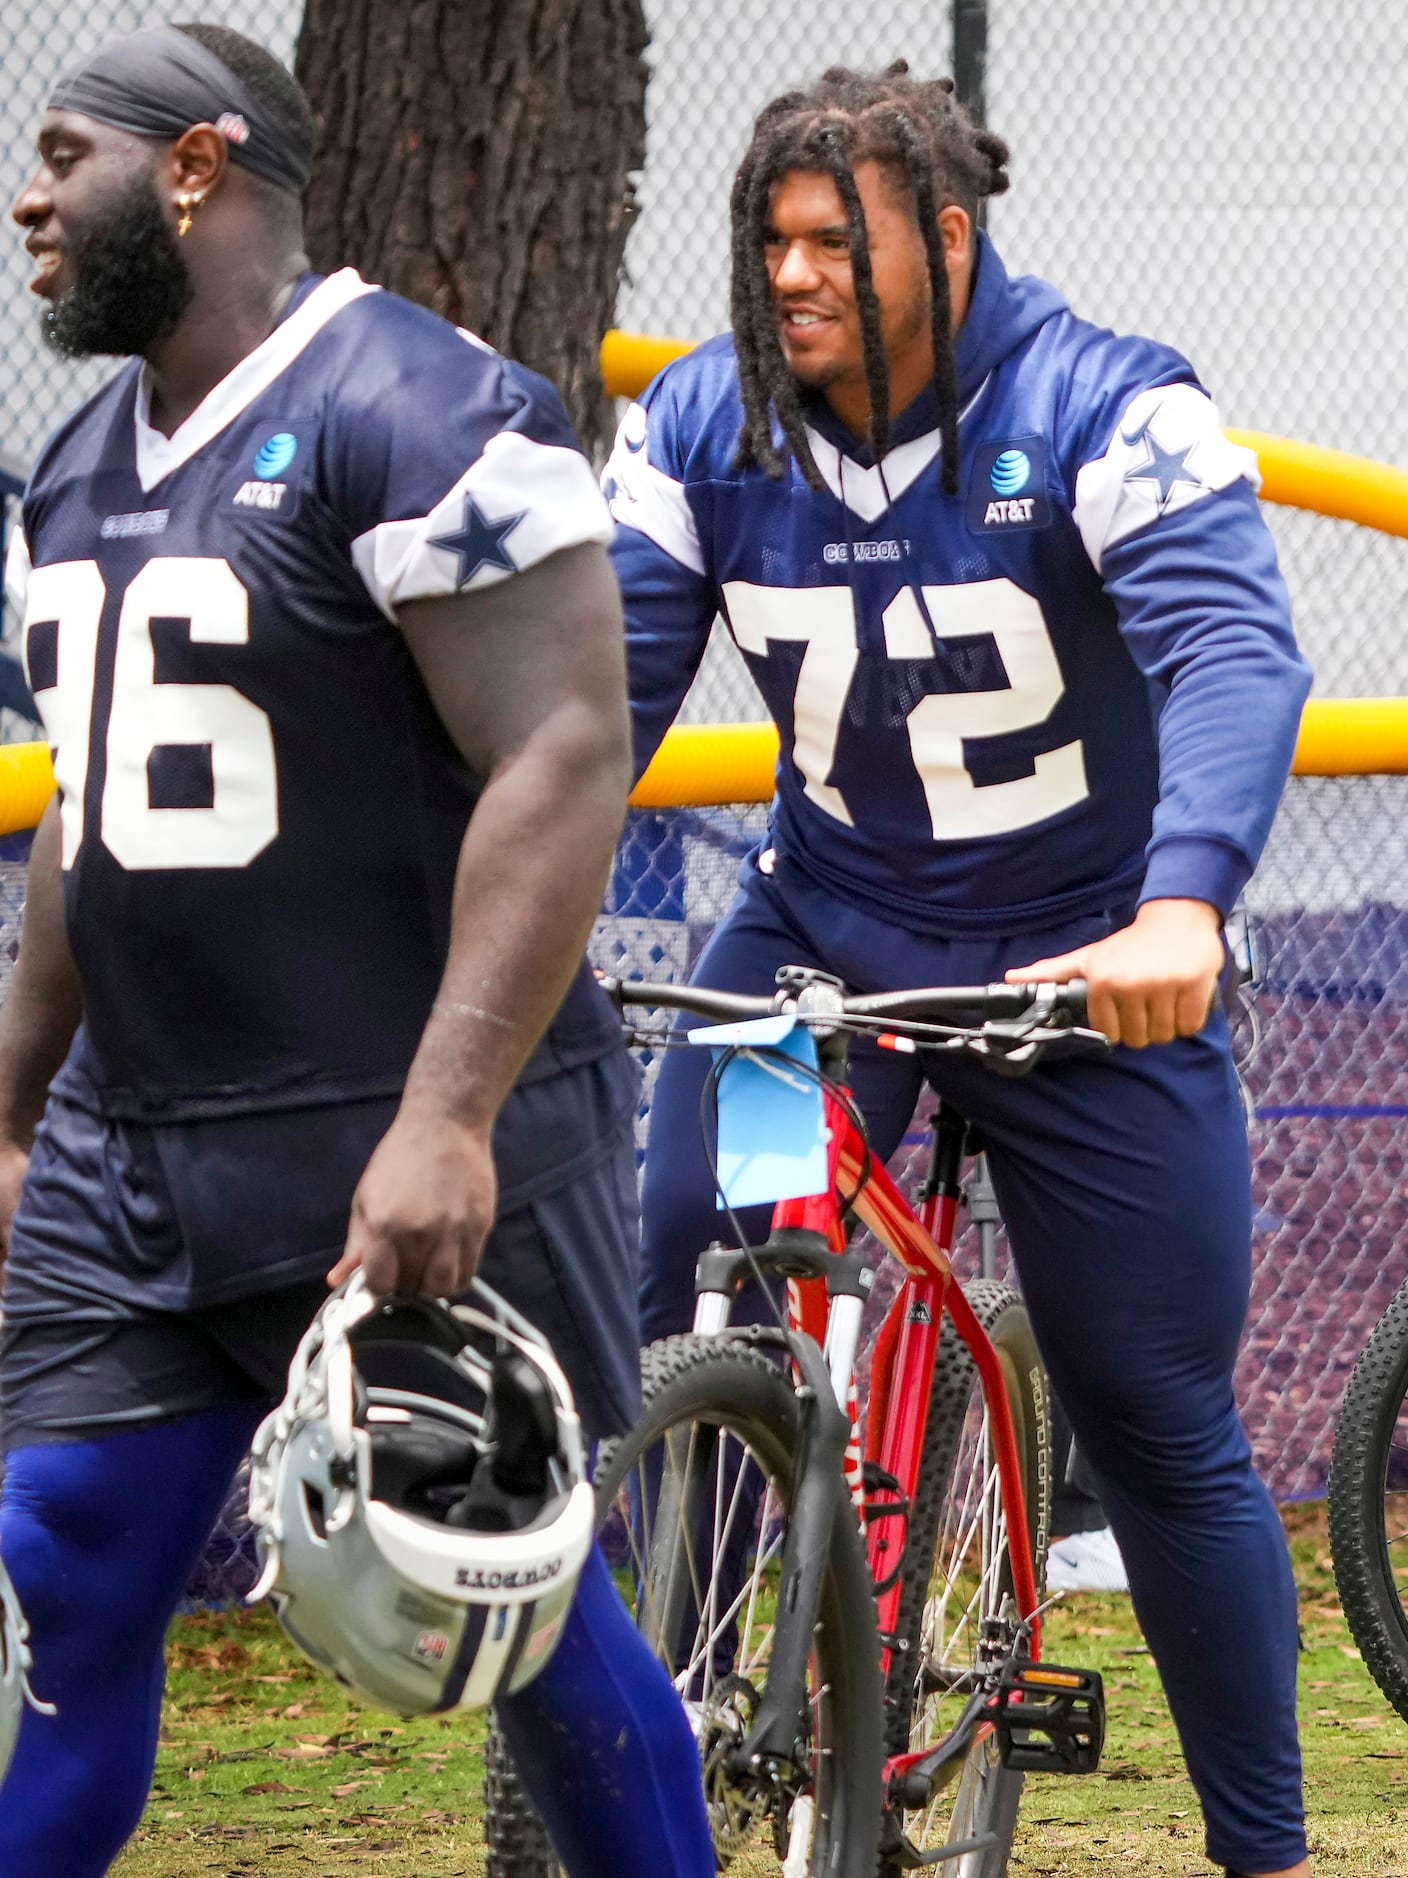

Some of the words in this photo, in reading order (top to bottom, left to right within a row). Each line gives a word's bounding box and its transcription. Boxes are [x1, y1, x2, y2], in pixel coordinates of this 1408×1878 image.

[232, 481, 287, 510] AT&T
[983, 498, 1035, 525] AT&T
[21, 557, 280, 871] 96
[721, 577, 1090, 841] 72
[1029, 1366, 1046, 1445] GROUND
[1035, 1449, 1051, 1565] CONTROL
